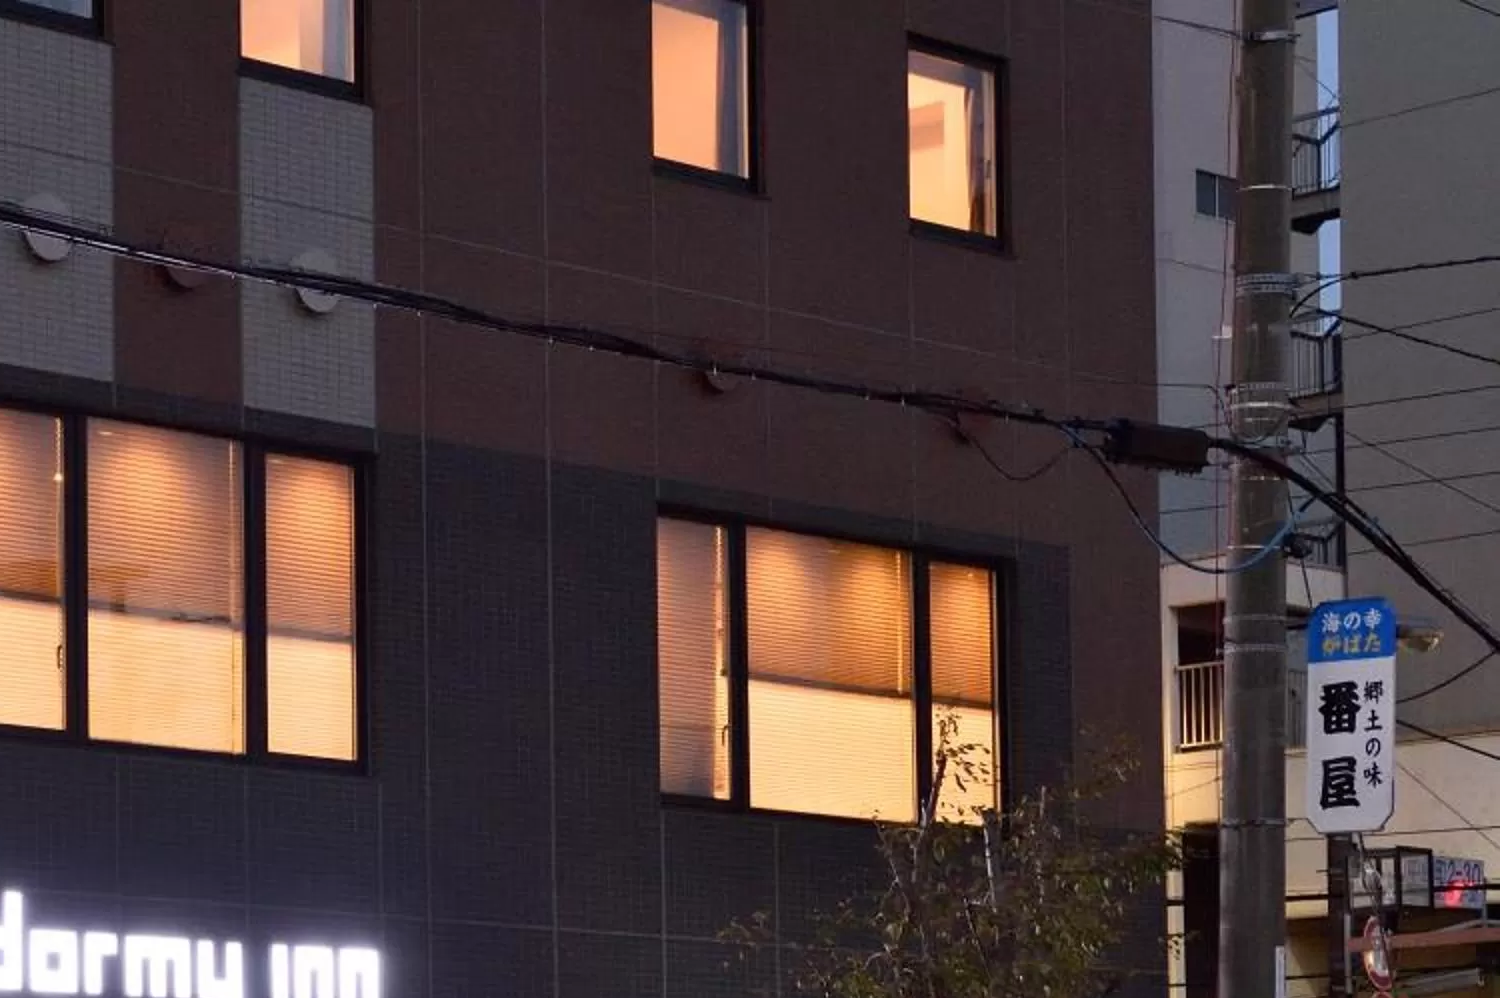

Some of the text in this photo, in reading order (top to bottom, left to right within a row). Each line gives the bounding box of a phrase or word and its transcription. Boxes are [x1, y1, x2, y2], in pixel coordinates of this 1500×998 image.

[1322, 608, 1382, 633] 海の幸
[1318, 680, 1361, 811] 番屋
[1363, 680, 1384, 789] 郷土の味
